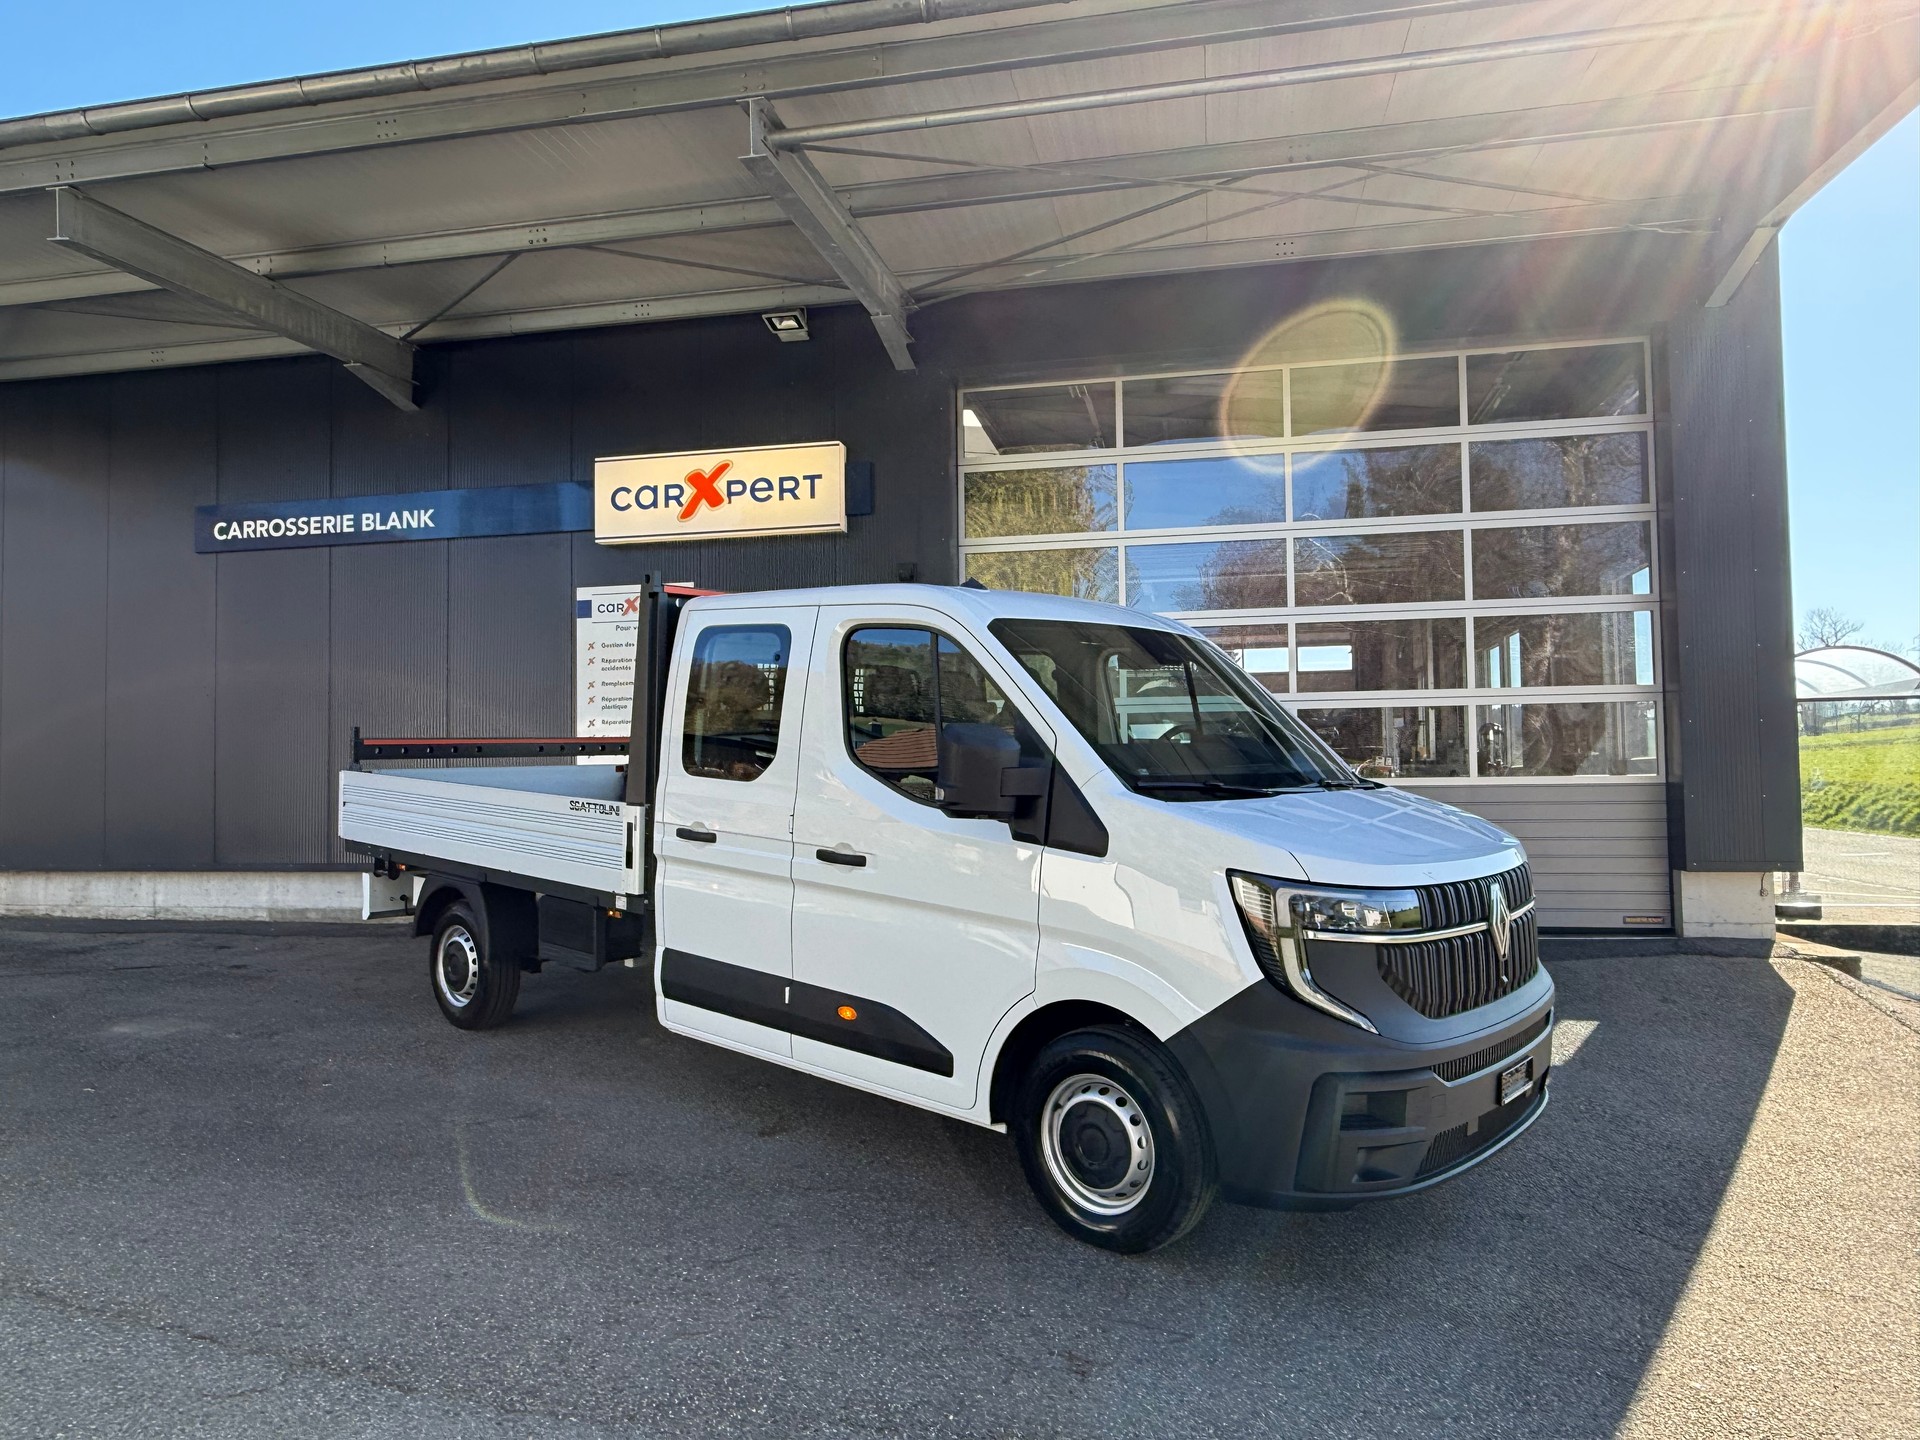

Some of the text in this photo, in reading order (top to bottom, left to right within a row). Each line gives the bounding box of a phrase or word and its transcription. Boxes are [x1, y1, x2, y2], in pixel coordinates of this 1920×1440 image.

[213, 509, 435, 541] CARROSSERIE BLANK
[601, 680, 634, 688] Remplacem
